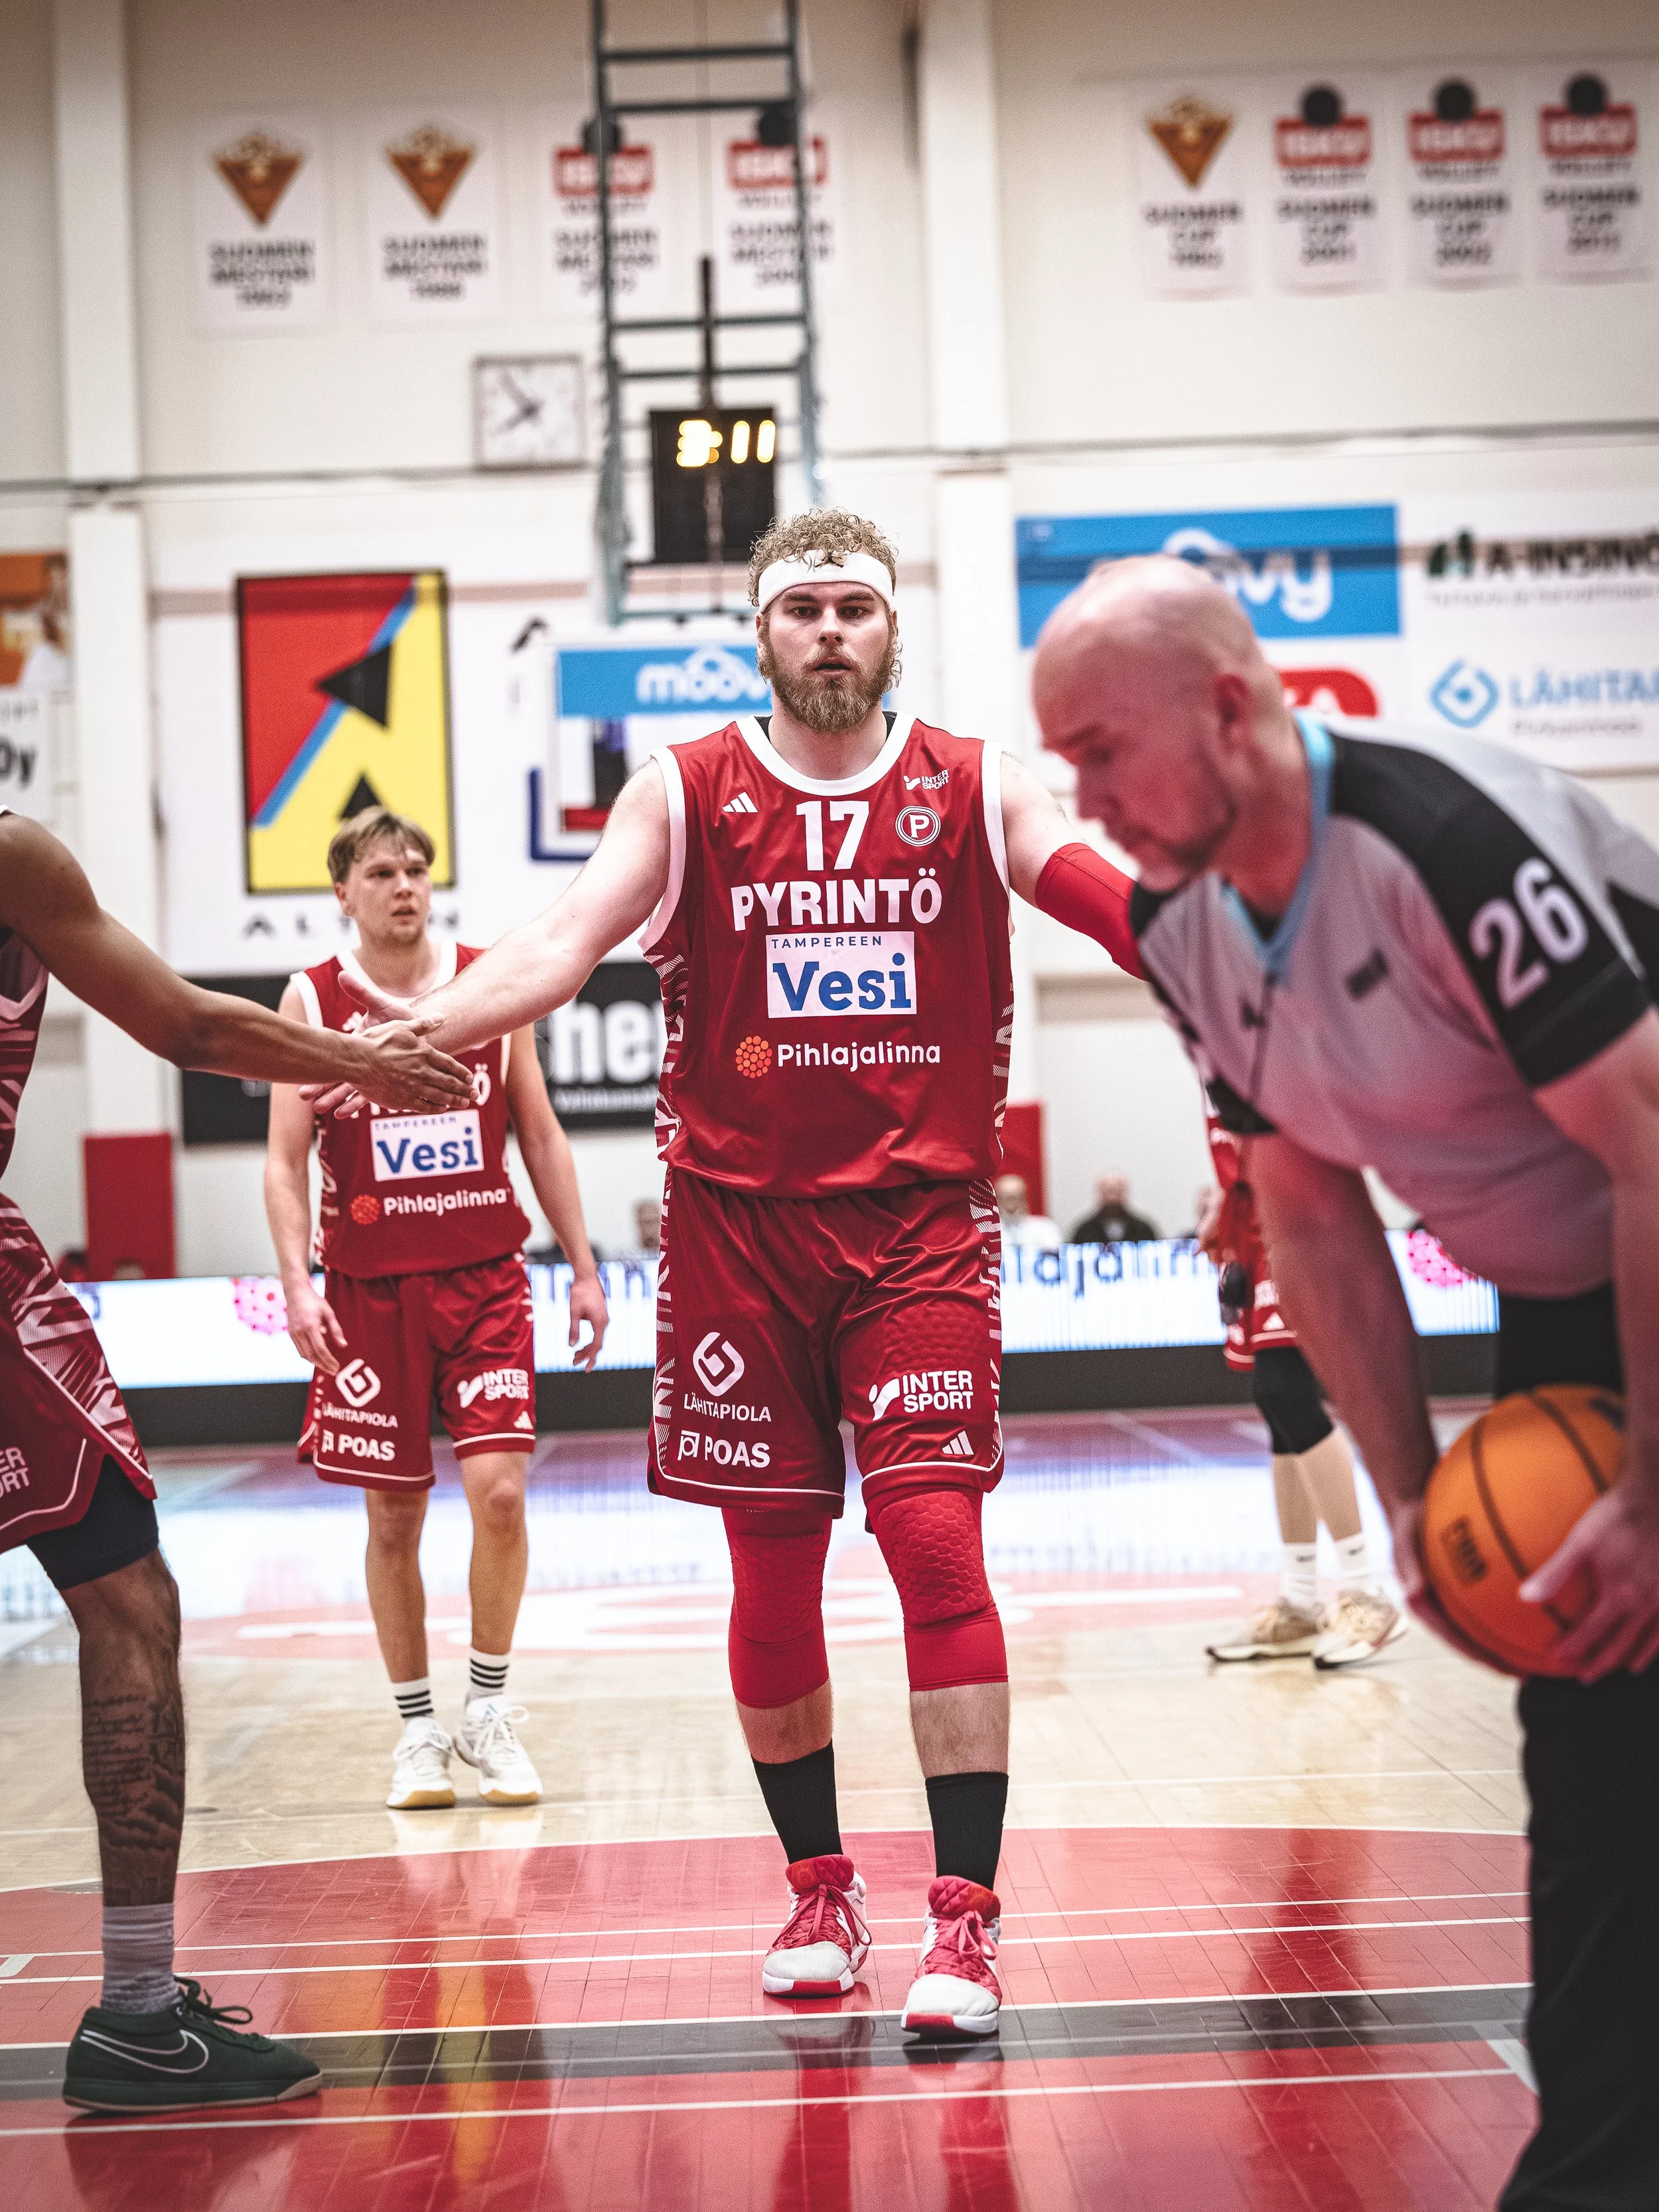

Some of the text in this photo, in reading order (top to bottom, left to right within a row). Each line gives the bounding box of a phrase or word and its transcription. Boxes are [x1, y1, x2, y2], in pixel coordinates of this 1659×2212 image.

[1508, 666, 1659, 708] LÄHITA
[921, 769, 949, 784] INTER
[922, 776, 949, 790] SPORT
[796, 800, 869, 871] 17
[908, 814, 930, 838] P
[731, 867, 942, 931] PYRINTÖ
[771, 935, 883, 949] TAMPEREEN
[1467, 857, 1589, 1009] 26
[772, 952, 912, 1012] Vesi
[778, 1040, 941, 1072] Pihlajalinna
[377, 1126, 478, 1174] Vesi
[383, 1189, 507, 1217] Pihlajalinna
[483, 1368, 529, 1386] INTER
[903, 1370, 974, 1394] INTER
[484, 1383, 530, 1401] SPORT
[904, 1391, 974, 1414] SPORT
[321, 1402, 399, 1429] LÄHITAPIOLA
[684, 1392, 772, 1422] LÄHITAPIOLA
[338, 1434, 396, 1462] POAS
[704, 1435, 771, 1469] POAS
